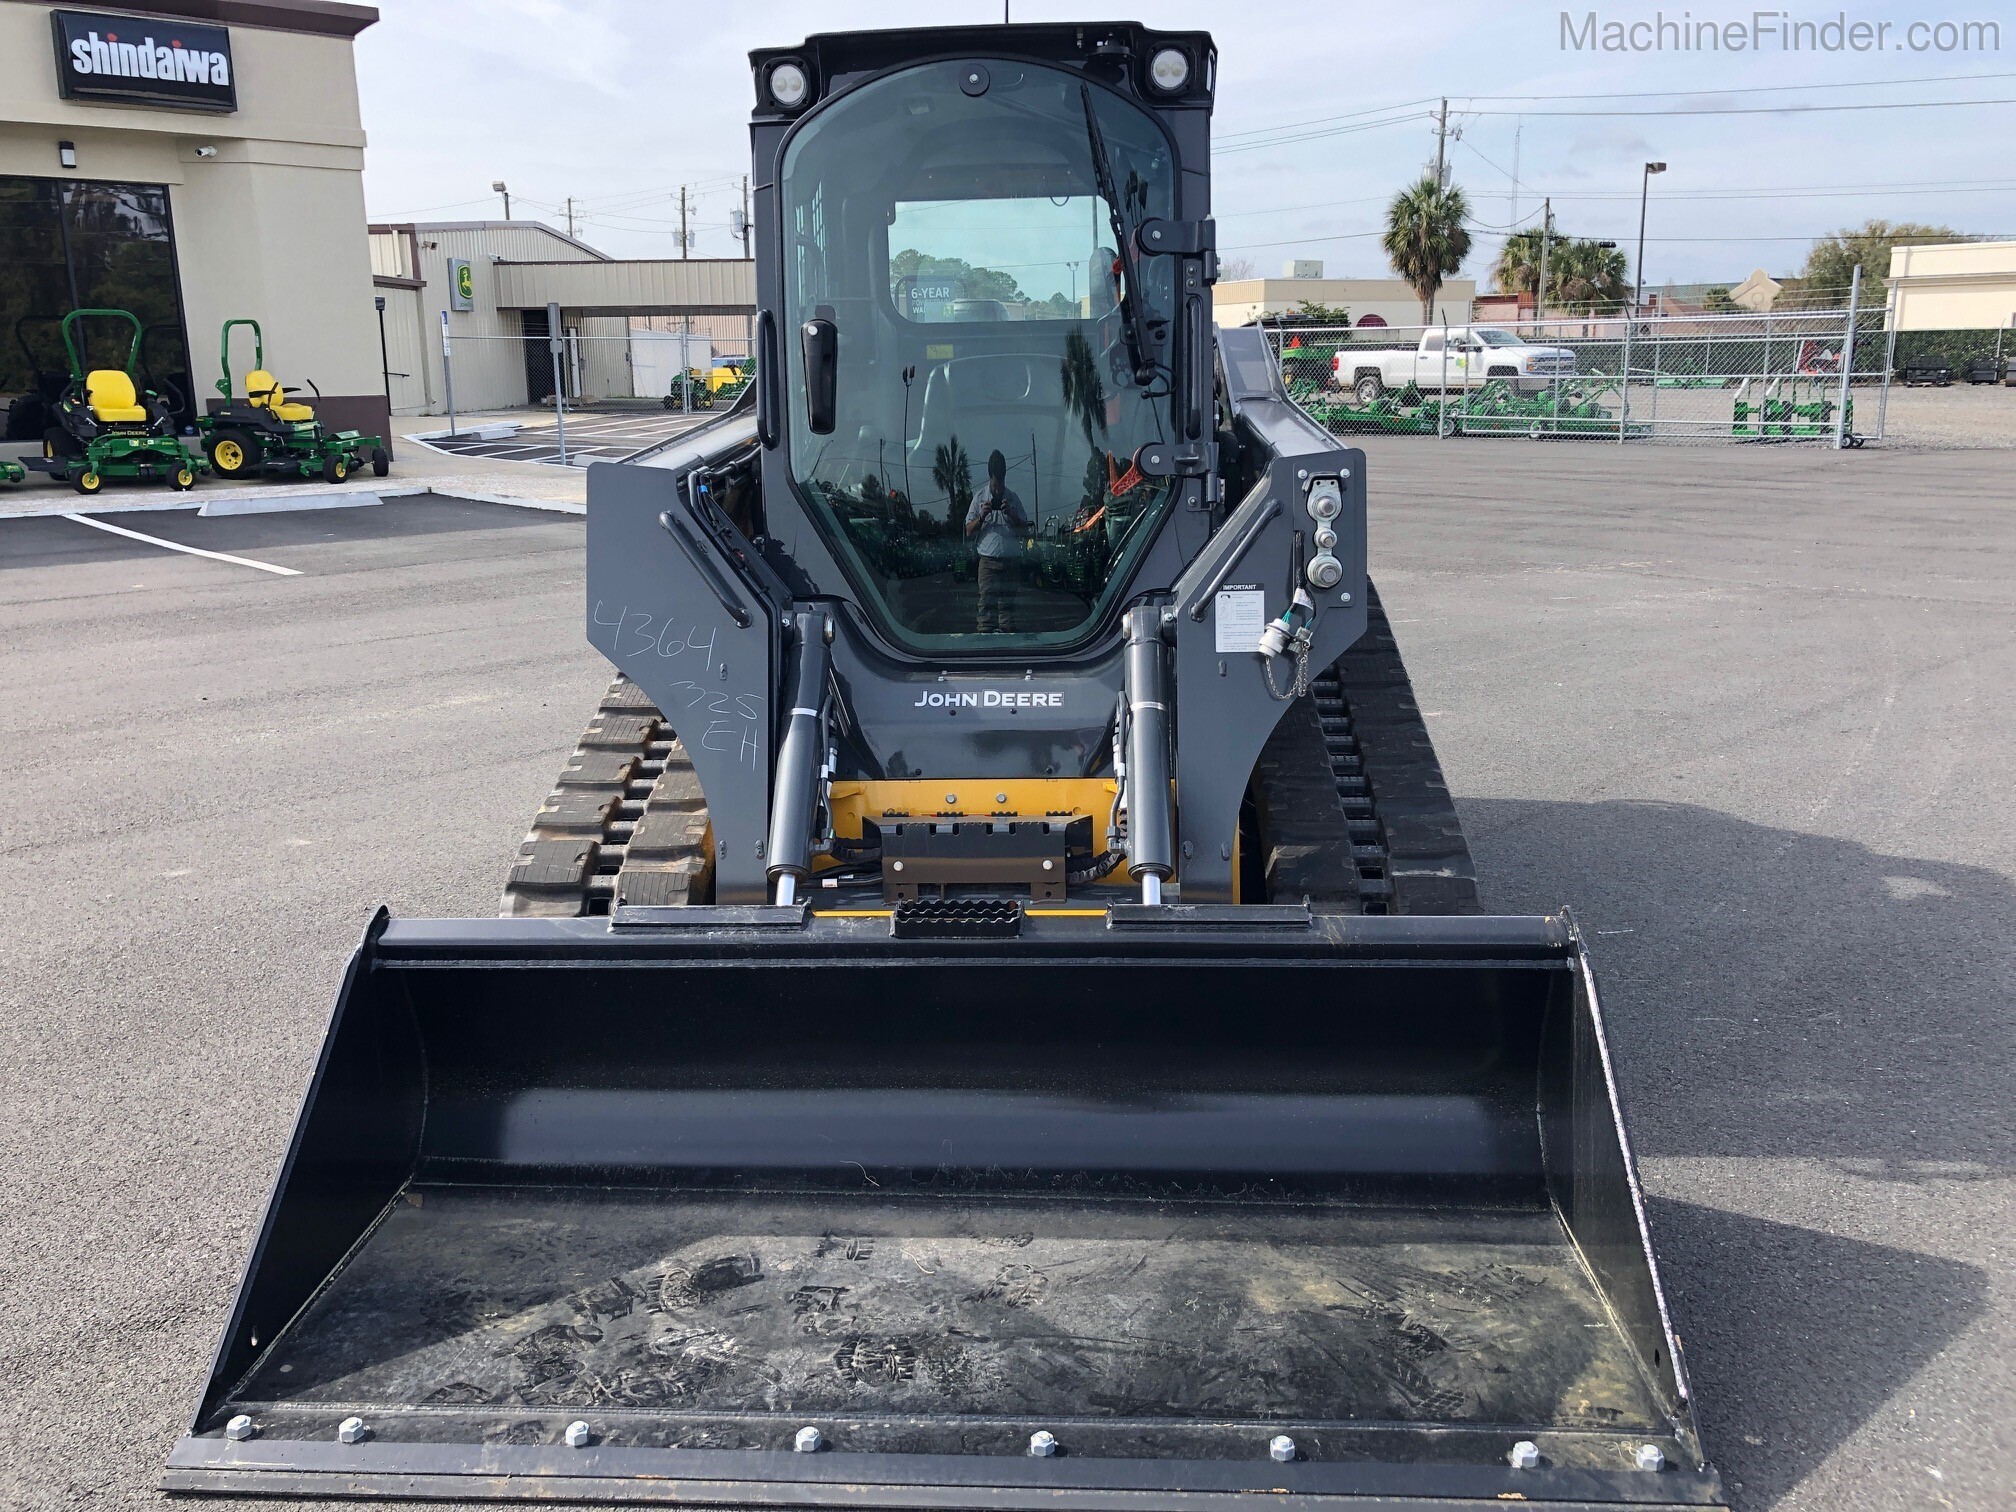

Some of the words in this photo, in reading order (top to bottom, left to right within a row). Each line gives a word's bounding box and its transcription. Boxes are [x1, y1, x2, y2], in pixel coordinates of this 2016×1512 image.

[70, 31, 229, 86] shindaiwa
[911, 287, 950, 299] 6-YEAR
[594, 600, 717, 672] 4364
[914, 691, 978, 707] JOHN
[983, 691, 1063, 707] DEERE
[702, 720, 759, 771] EH
